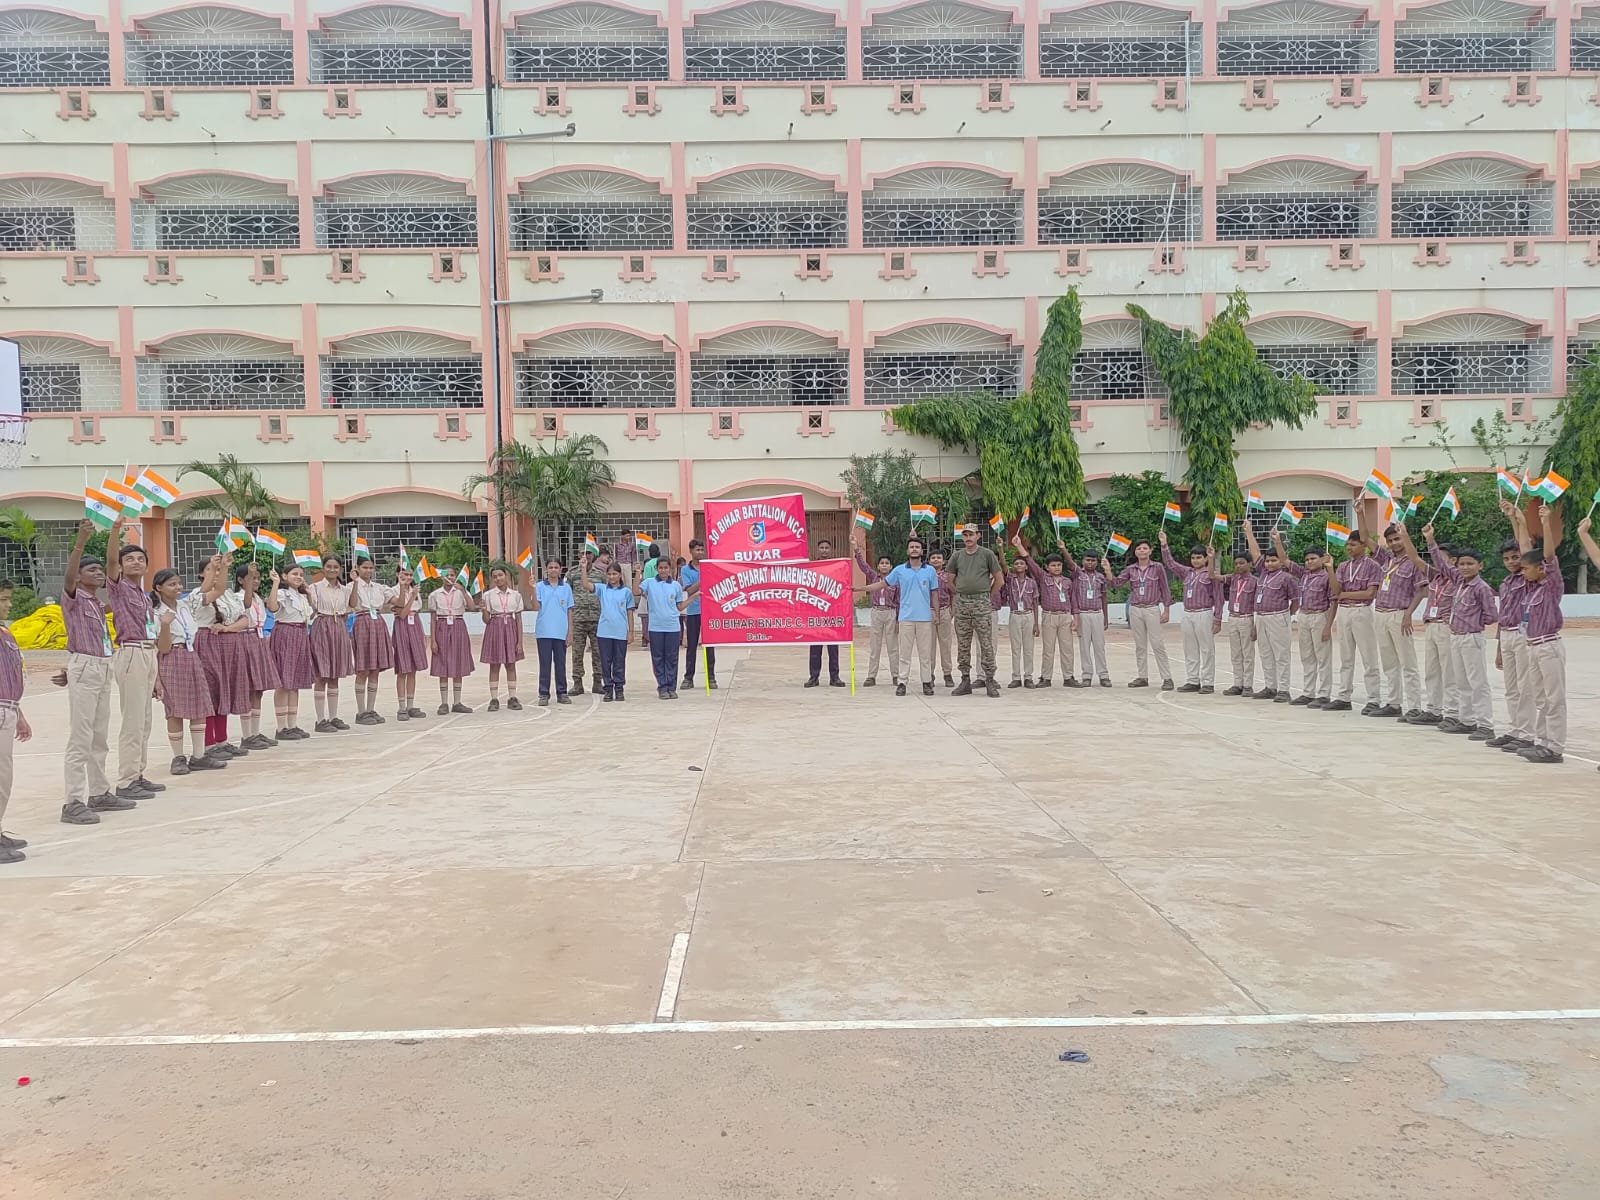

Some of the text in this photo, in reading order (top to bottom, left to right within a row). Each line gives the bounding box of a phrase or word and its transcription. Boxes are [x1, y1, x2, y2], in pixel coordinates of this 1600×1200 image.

[709, 504, 804, 545] 30 BIHAR BATTALION NCC
[734, 549, 781, 561] BUXAR
[709, 566, 842, 602] VANDE BHARAT AWARENESS DIVAS
[721, 587, 831, 613] वन्दे मातरम् दिवस
[709, 619, 720, 629] 30
[723, 618, 755, 629] BIHAR
[808, 616, 845, 628] BUXAR
